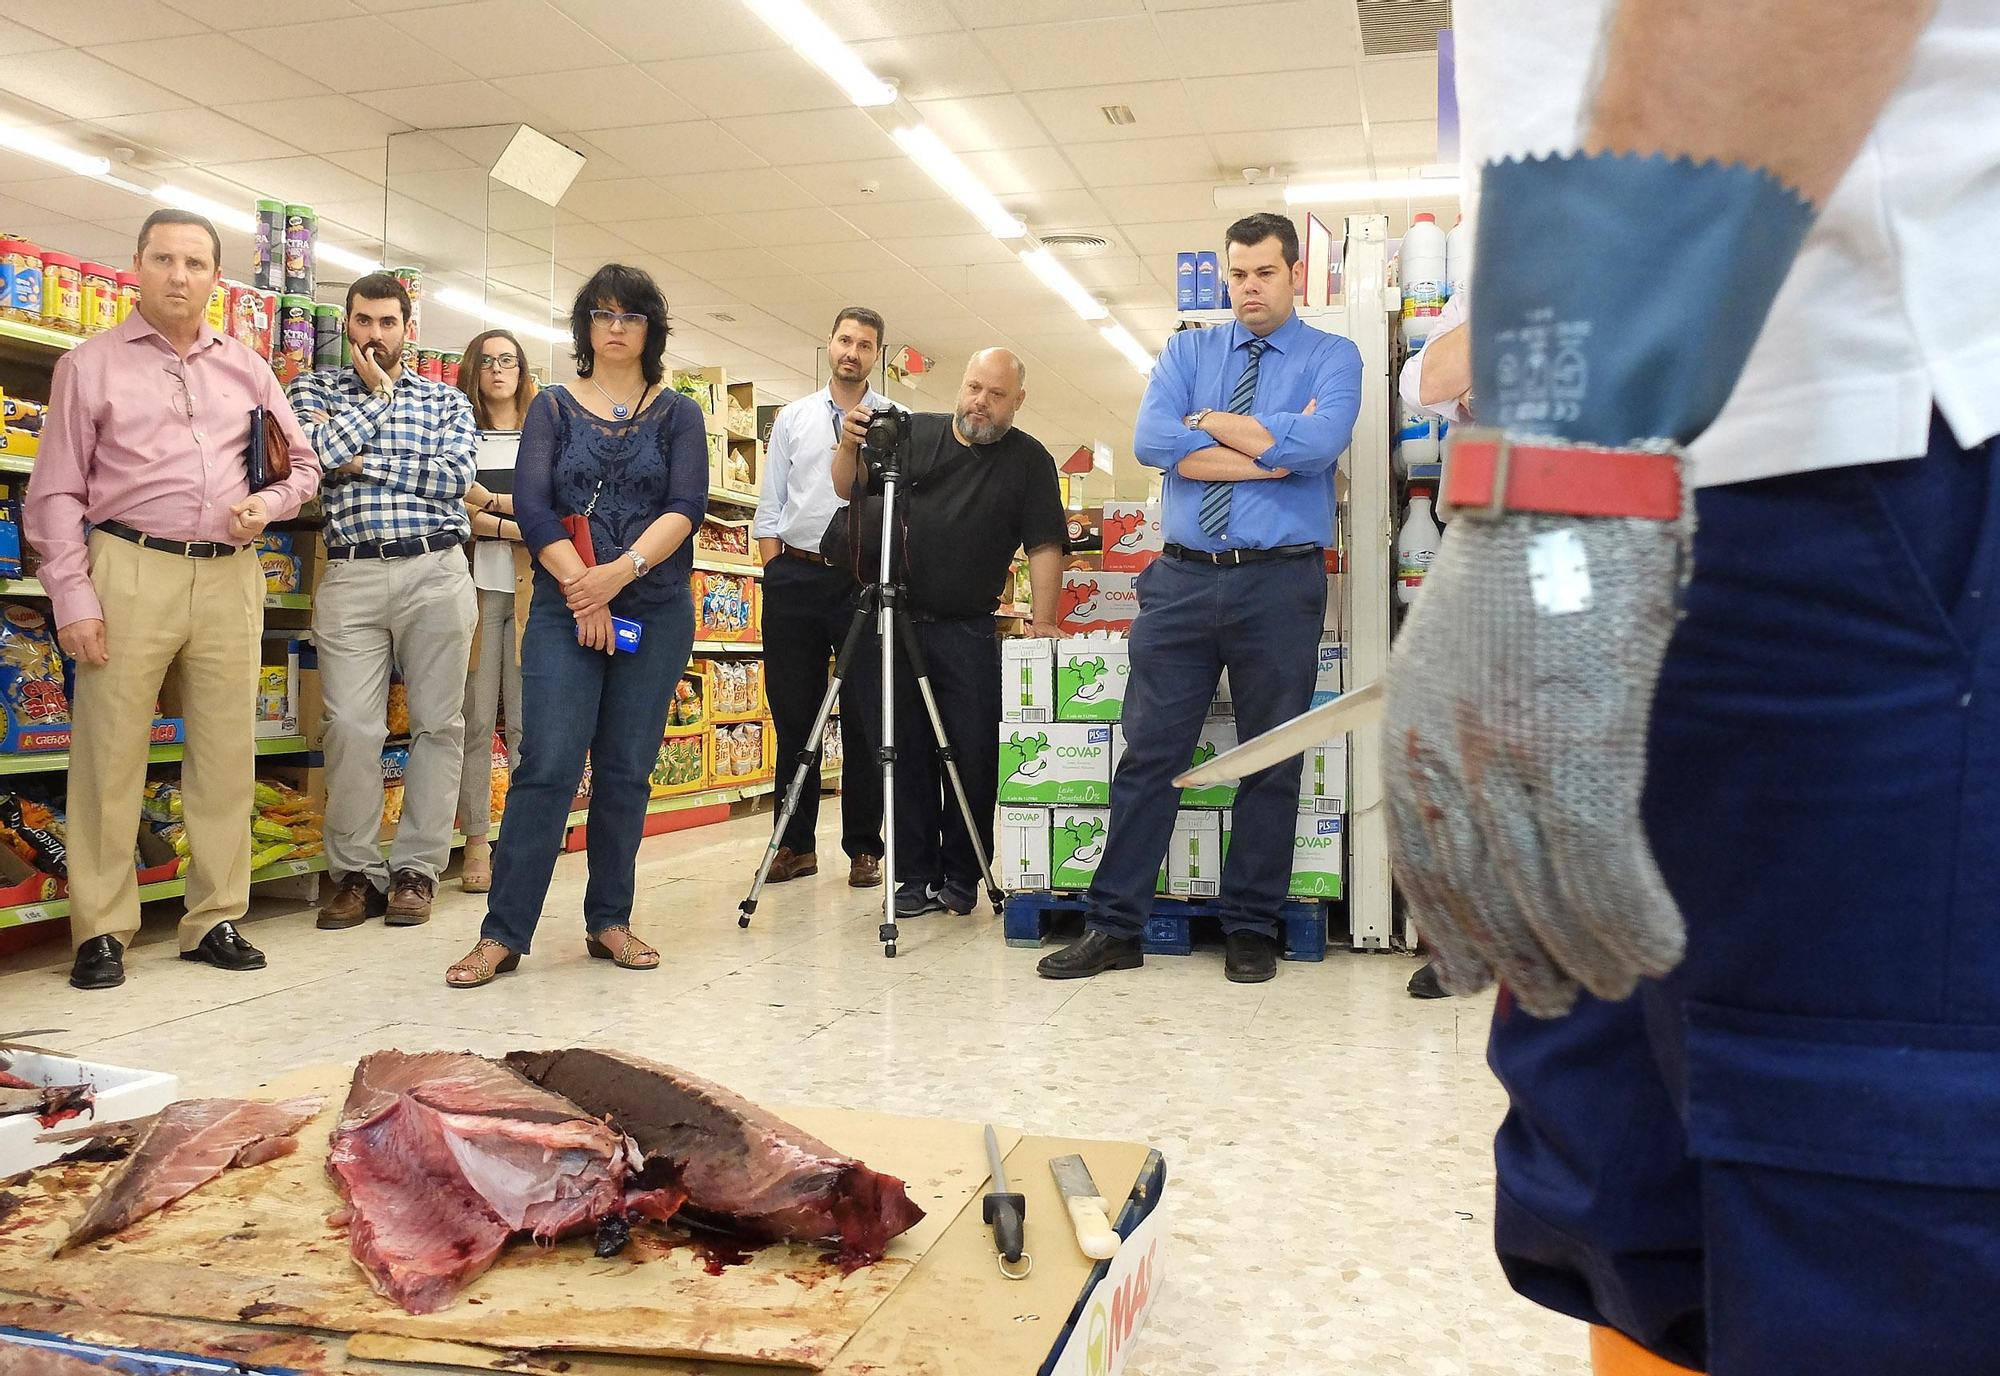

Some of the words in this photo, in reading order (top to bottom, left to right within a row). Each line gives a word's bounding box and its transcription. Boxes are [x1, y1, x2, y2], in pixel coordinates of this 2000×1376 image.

[283, 329, 309, 342] XTRA
[695, 579, 703, 632] NUEVO
[1088, 729, 1100, 740] PLS
[1056, 747, 1102, 757] COVAP
[1006, 812, 1040, 821] COVAP
[1318, 821, 1331, 831] PLS
[1294, 836, 1332, 849] OVAP
[1108, 1238, 1157, 1373] MAS
